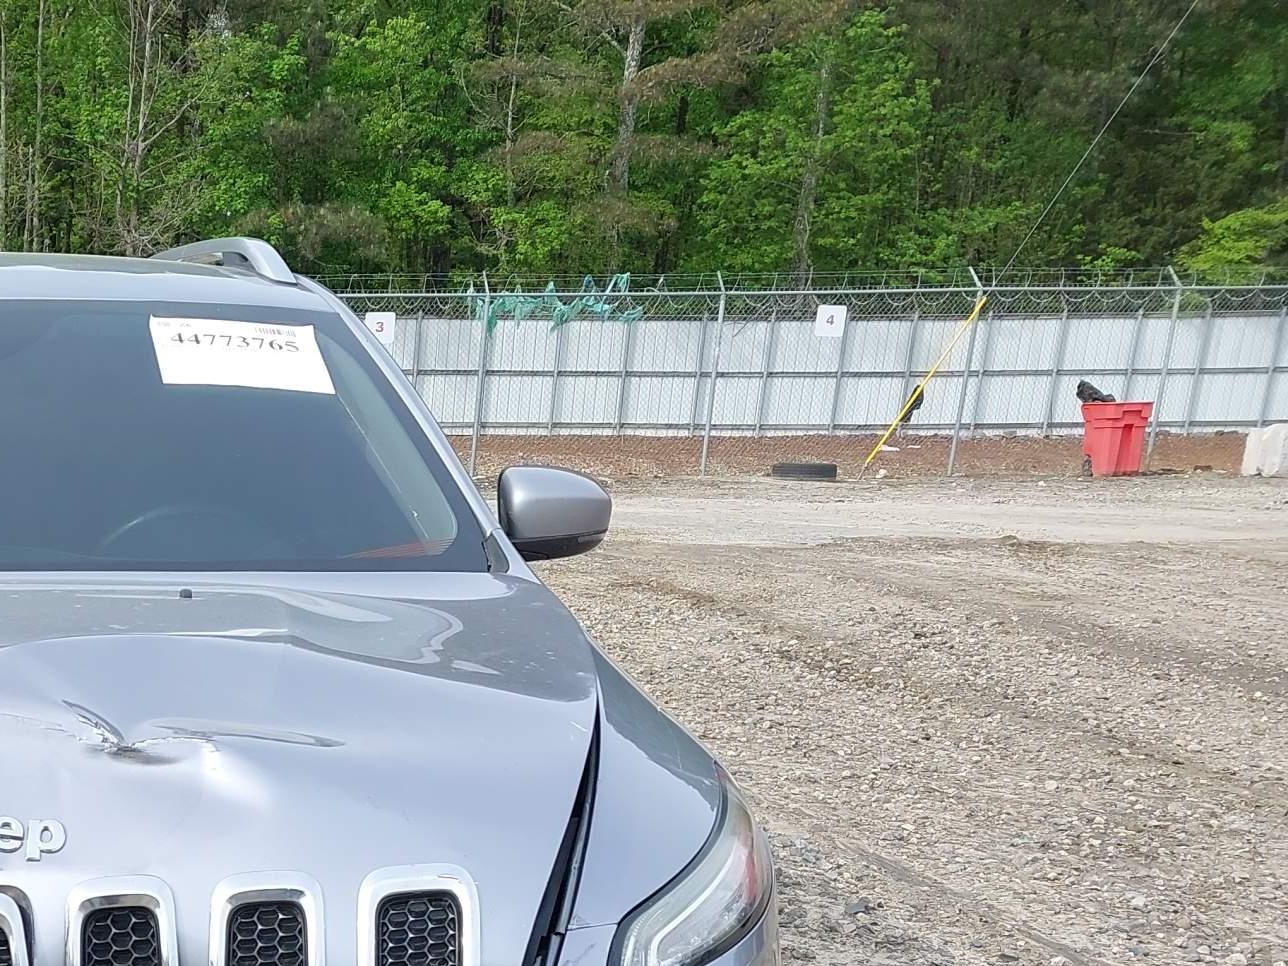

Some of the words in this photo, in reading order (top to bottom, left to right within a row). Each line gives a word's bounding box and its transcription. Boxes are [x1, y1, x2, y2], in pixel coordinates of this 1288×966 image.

[826, 314, 835, 326] 4
[375, 321, 384, 333] 3
[170, 332, 300, 353] 44773765
